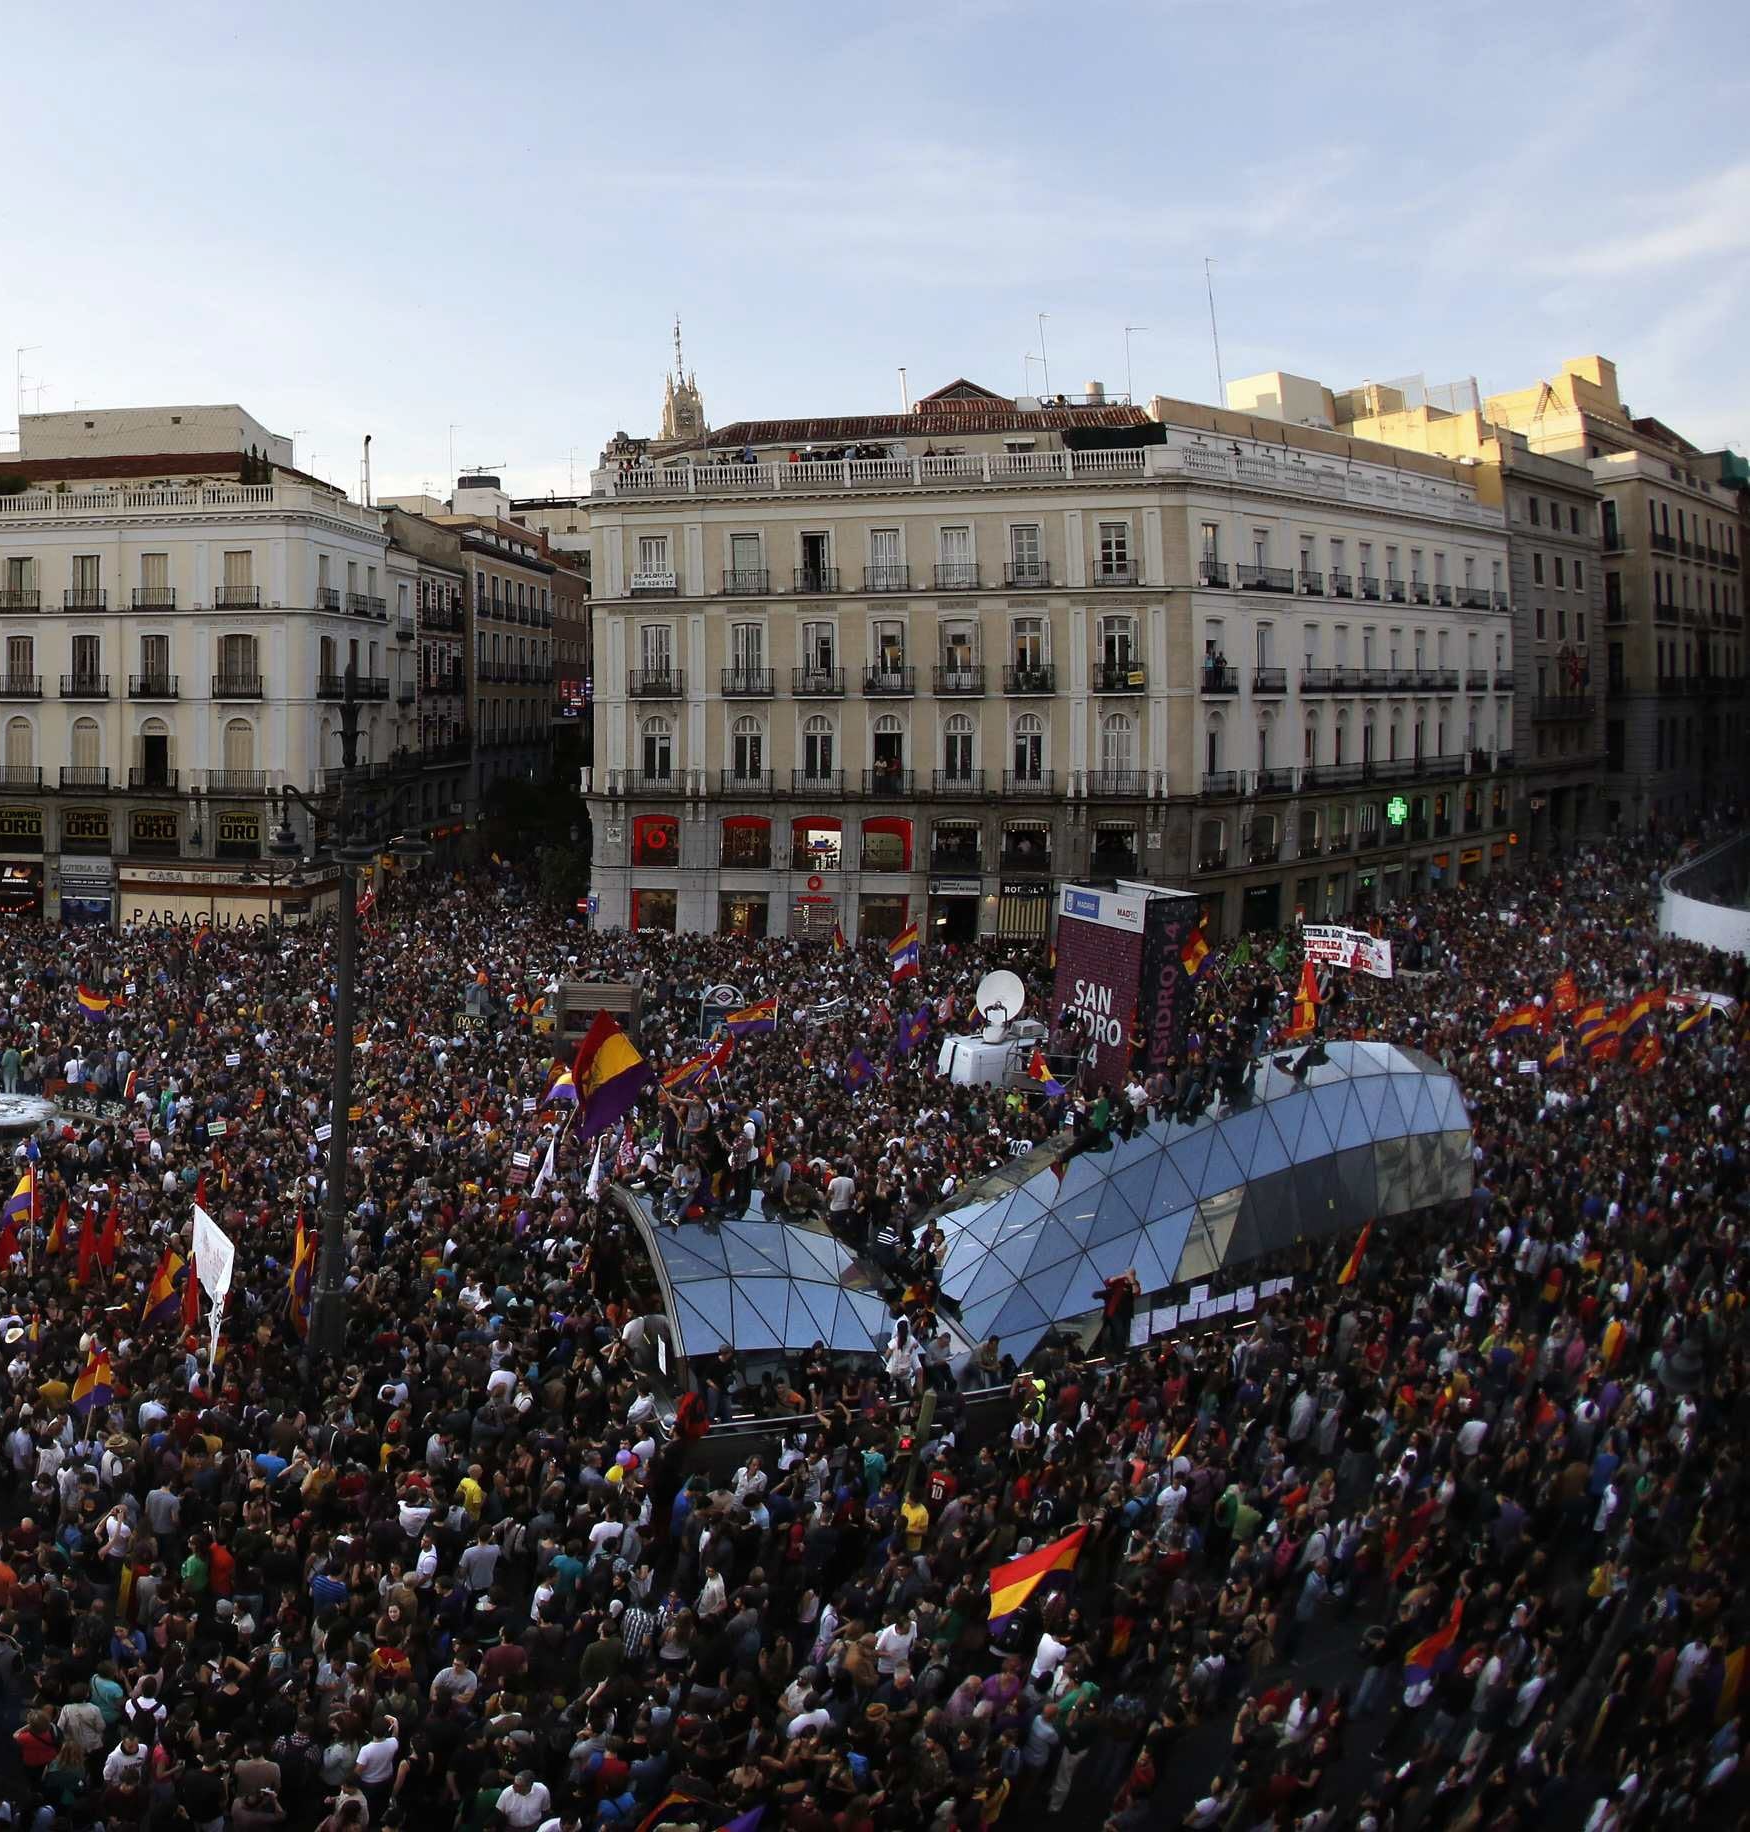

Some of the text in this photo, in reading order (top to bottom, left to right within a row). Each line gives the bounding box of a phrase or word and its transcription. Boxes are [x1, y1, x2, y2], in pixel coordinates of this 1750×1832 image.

[0, 810, 42, 819] COMPRO
[66, 813, 108, 821] COMPRO
[134, 815, 177, 824] COMPRO
[219, 816, 259, 824] COMPRO
[0, 819, 42, 834] ORO
[66, 820, 108, 836] ORO
[134, 823, 177, 838] ORO
[220, 824, 259, 840] ORO
[147, 871, 184, 882] CASA
[133, 908, 267, 929] PARAGUAS
[1074, 979, 1112, 1015] SAN
[1010, 1141, 1028, 1156] NO
